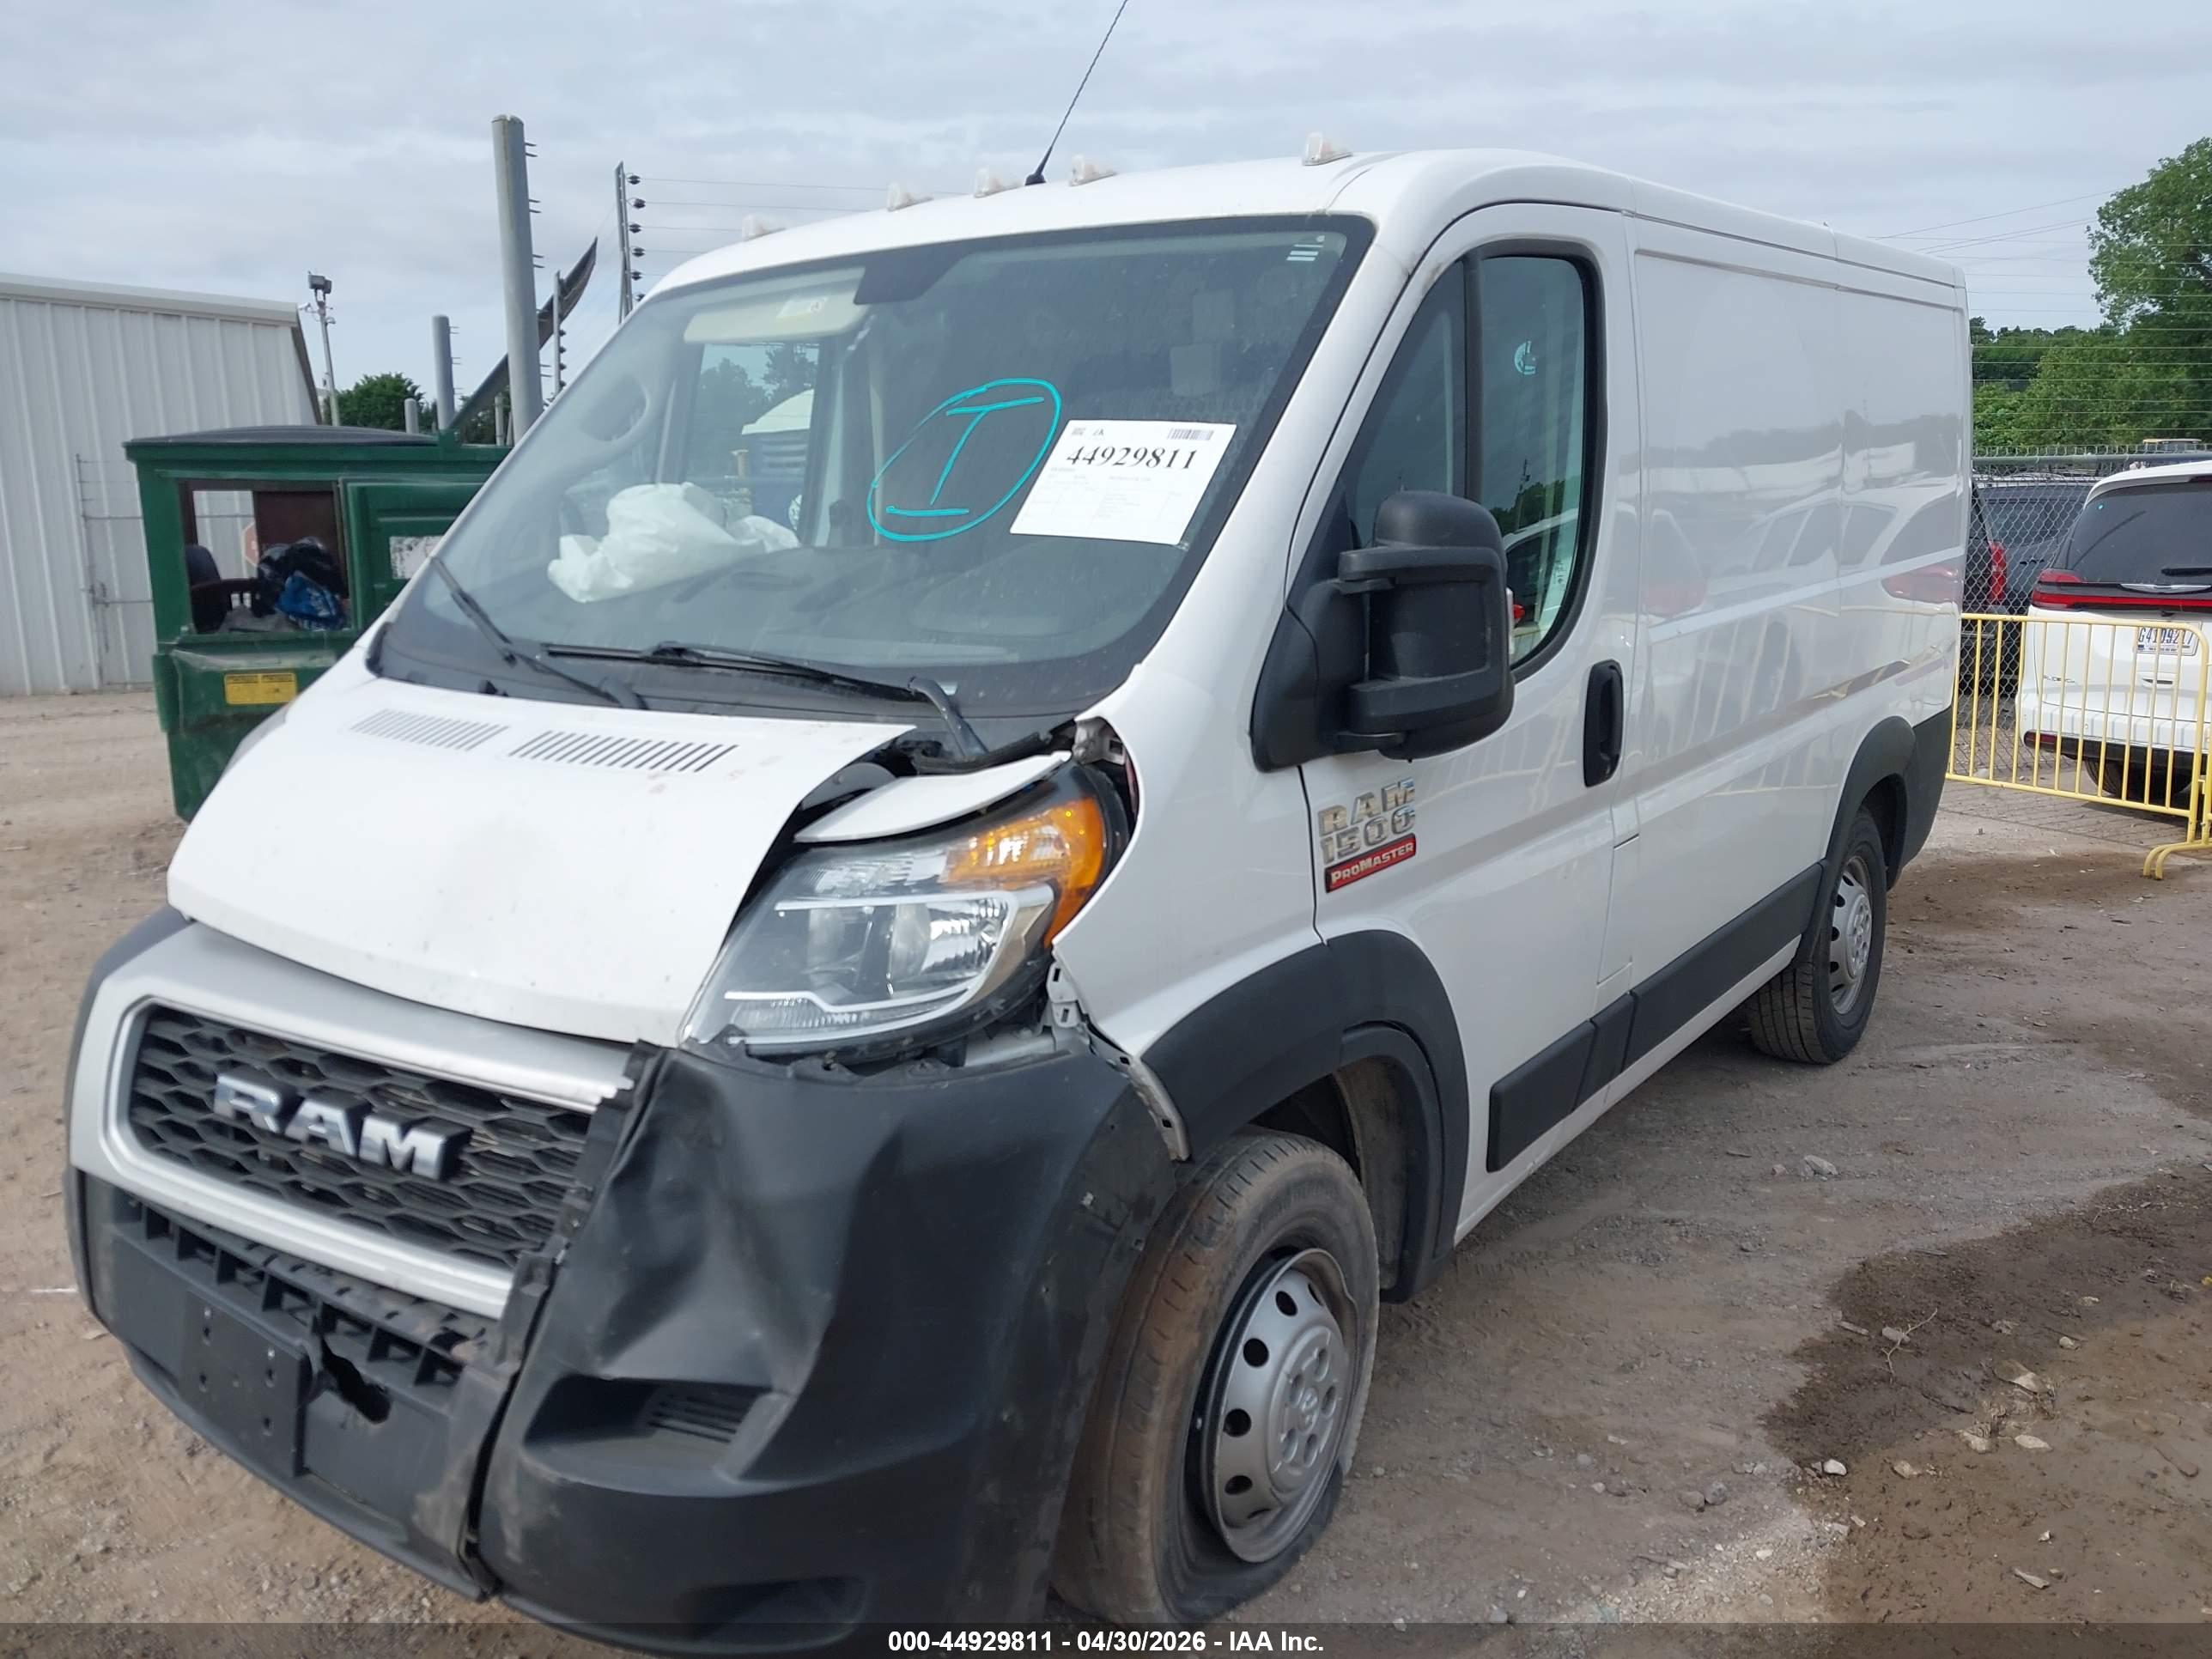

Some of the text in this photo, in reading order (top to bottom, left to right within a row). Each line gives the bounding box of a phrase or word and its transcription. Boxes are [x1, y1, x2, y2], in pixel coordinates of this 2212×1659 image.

[1066, 446, 1198, 469] 44929811
[1318, 777, 1415, 837] RAM
[1321, 805, 1415, 865] 1500
[213, 1072, 455, 1181] RAM
